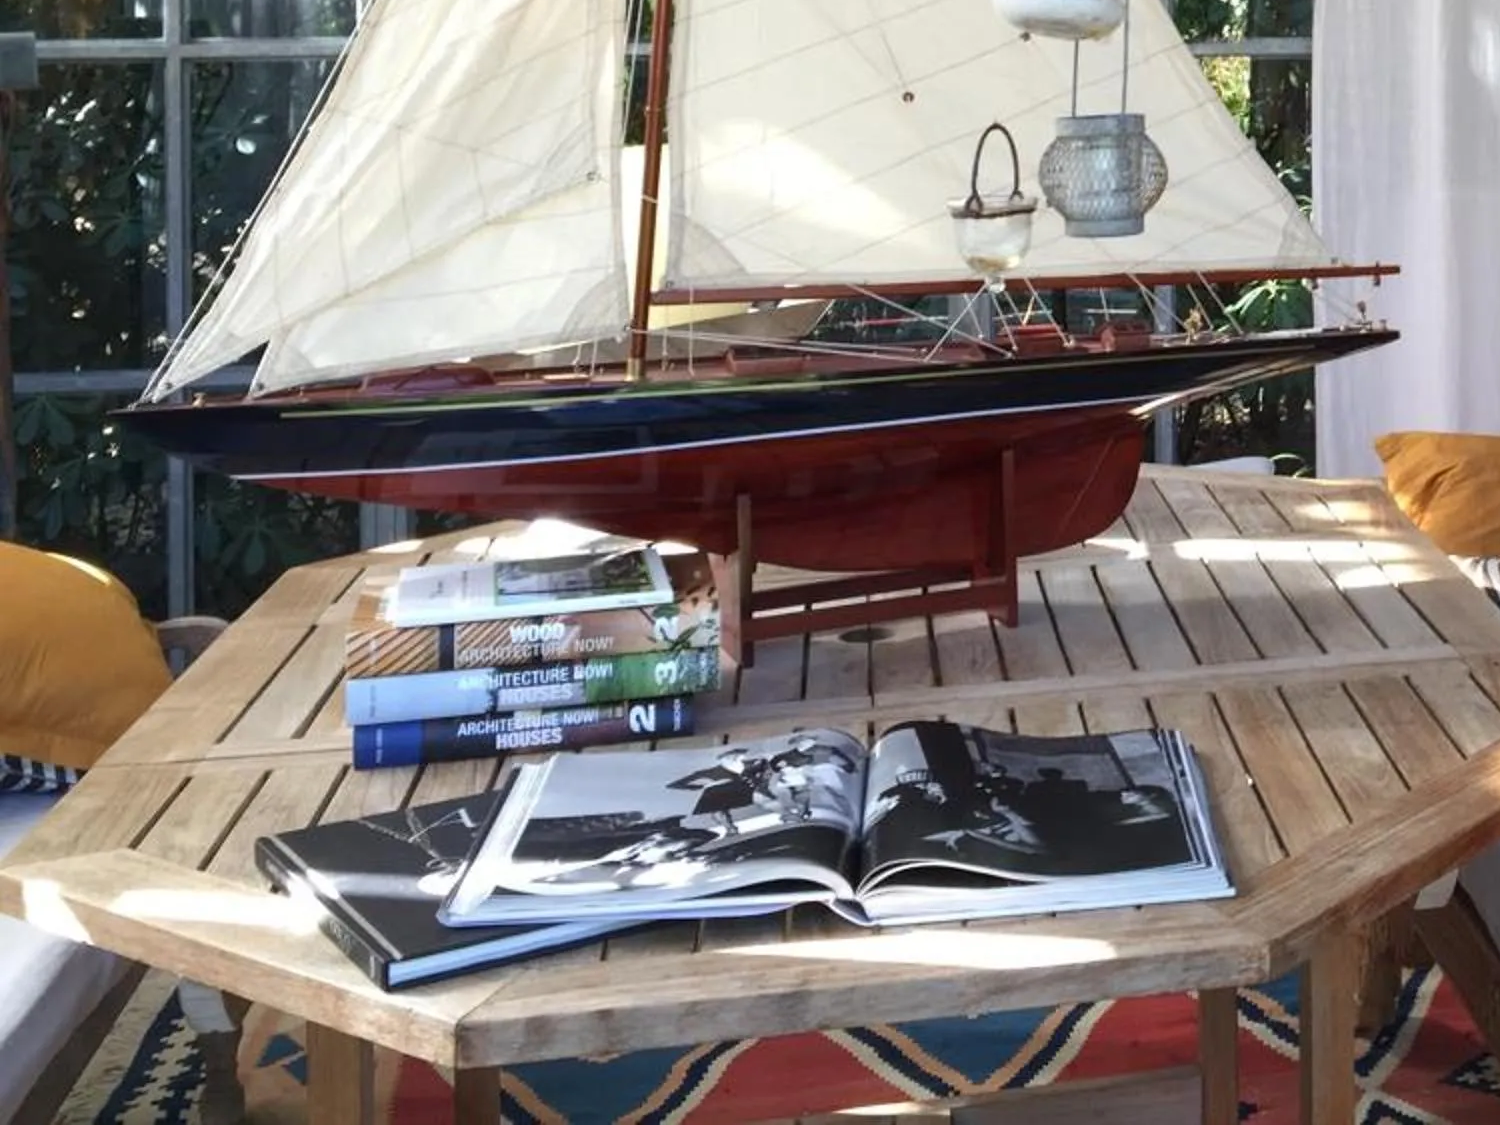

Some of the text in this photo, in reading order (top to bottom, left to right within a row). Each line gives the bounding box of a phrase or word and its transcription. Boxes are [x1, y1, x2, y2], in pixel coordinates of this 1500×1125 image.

[509, 622, 566, 644] WOOD
[654, 615, 680, 642] 2
[458, 636, 615, 662] ARCHITECTURE NOW!
[457, 662, 614, 691] ARCHITECTURE NOW!
[654, 660, 678, 686] 3
[498, 683, 574, 705] HOUSES
[456, 707, 600, 738] ARCHITECTURE NOW!
[629, 703, 656, 733] 2
[496, 727, 563, 750] HOUSES
